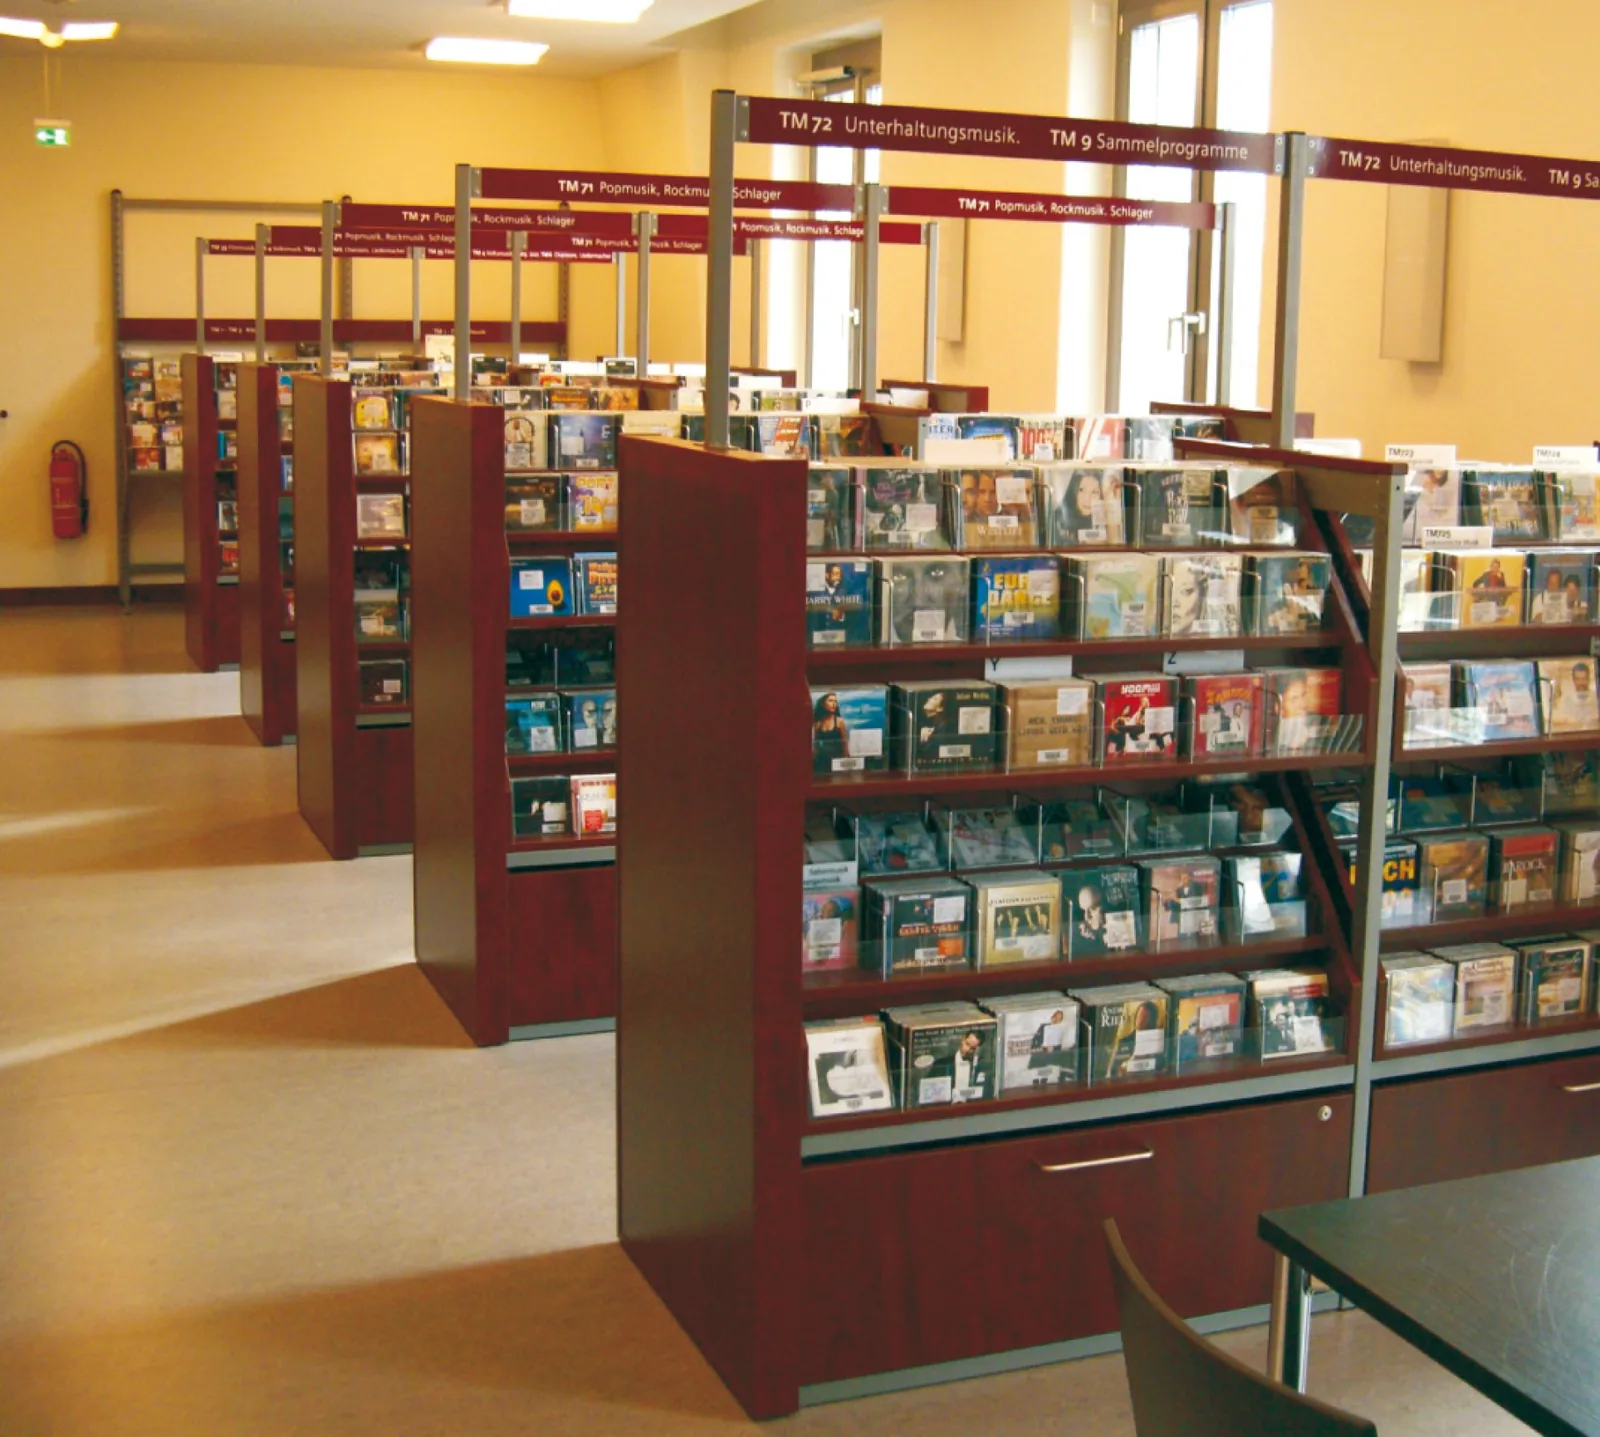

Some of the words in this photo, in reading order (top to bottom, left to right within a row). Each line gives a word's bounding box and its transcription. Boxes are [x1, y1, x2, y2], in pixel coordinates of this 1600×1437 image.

[780, 111, 809, 130] TM
[811, 116, 832, 133] 72
[845, 116, 1020, 146] Unterhaltungsmusik.
[1050, 128, 1077, 148] TM
[1081, 134, 1092, 152] 9
[1096, 132, 1249, 162] Sammelprogramme
[1339, 150, 1362, 168] TM
[1364, 156, 1381, 171] 72
[1390, 156, 1527, 182] Unterhaltungsmusik.
[1549, 169, 1569, 185] TM
[1573, 174, 1582, 189] 9
[558, 180, 578, 193] TM
[581, 183, 594, 195] 71
[600, 181, 661, 197] Popmusik,
[732, 186, 782, 203] Schlager
[402, 211, 418, 222] TM
[420, 214, 431, 224] 71
[484, 213, 534, 226] Rockmusik.
[537, 215, 576, 229] Schlager
[958, 198, 977, 210] TM
[978, 200, 990, 213] 71
[994, 200, 1048, 216] Popmusik,
[1050, 202, 1109, 217] Rockmusik.
[1110, 204, 1154, 220] Schlager
[740, 221, 784, 235] Popmusik,
[834, 226, 865, 238] Schlage
[571, 237, 585, 246] TM
